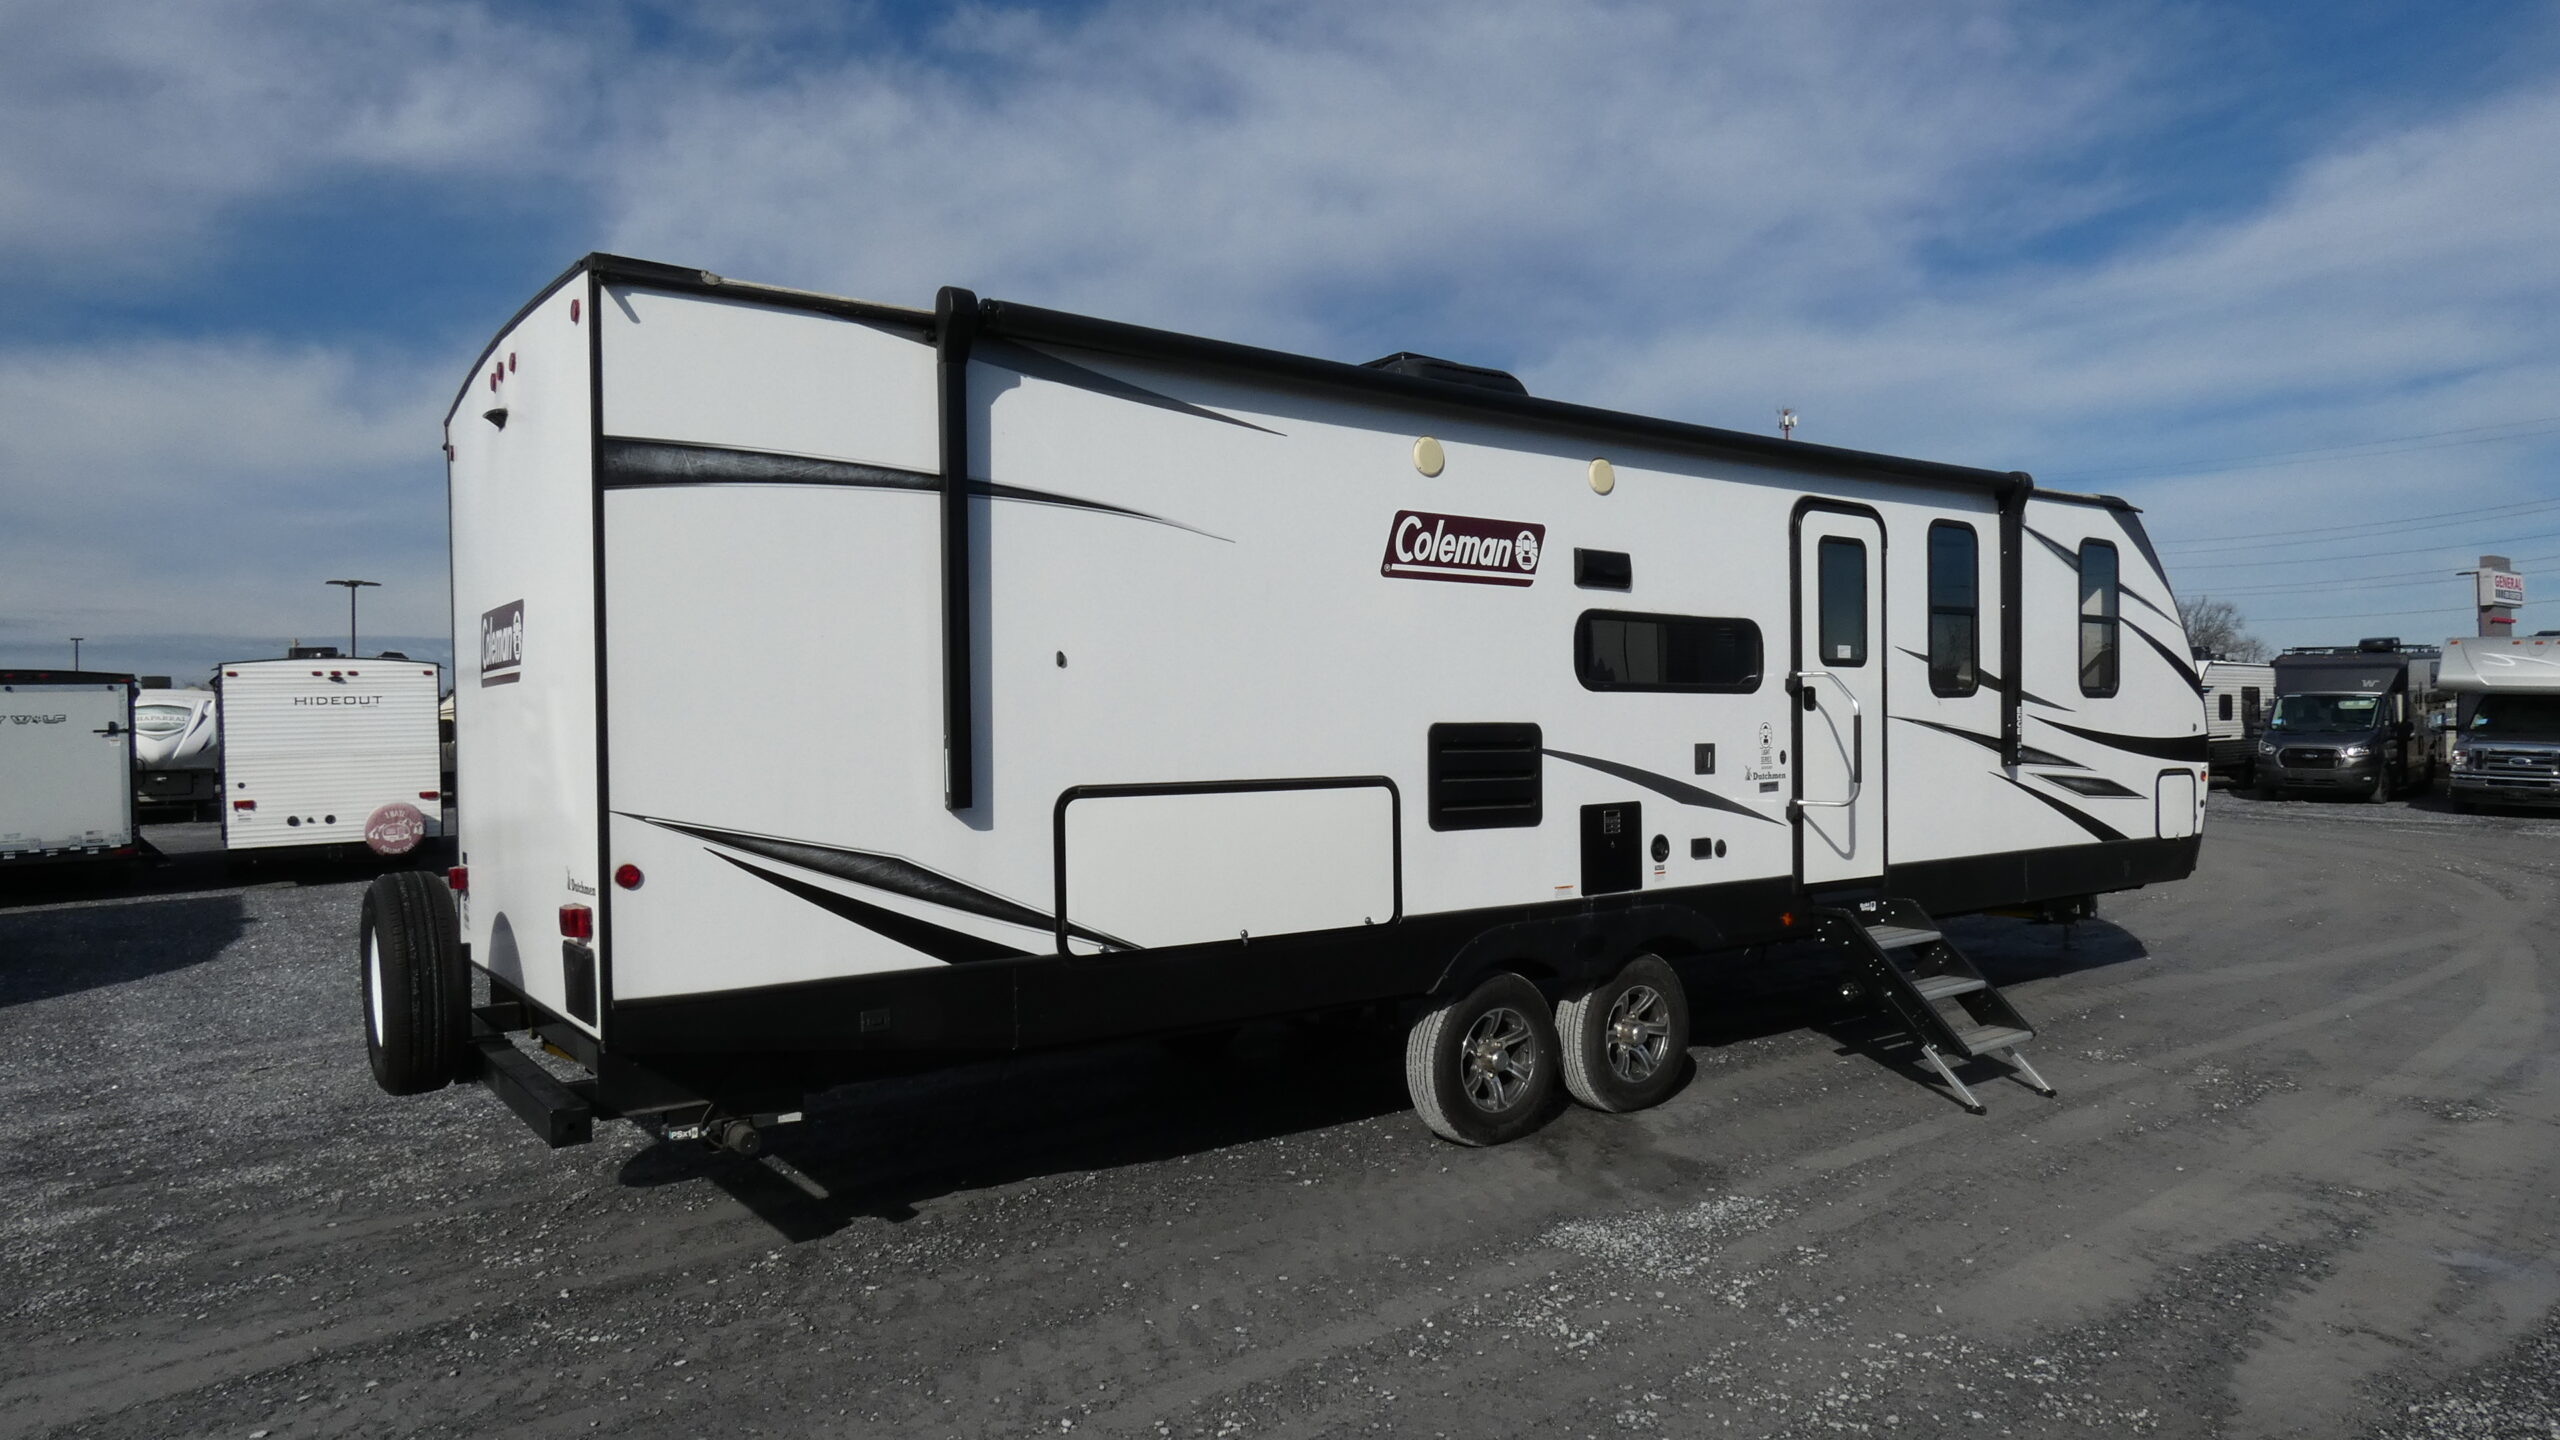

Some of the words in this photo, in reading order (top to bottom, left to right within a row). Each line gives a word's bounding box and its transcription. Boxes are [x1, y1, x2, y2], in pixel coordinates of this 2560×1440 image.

[1395, 515, 1513, 568] Coleman
[482, 616, 512, 670] Coleman
[294, 695, 383, 706] HIDEOUT
[1753, 772, 1786, 780] Dutchmen
[571, 878, 596, 896] Dutchmen
